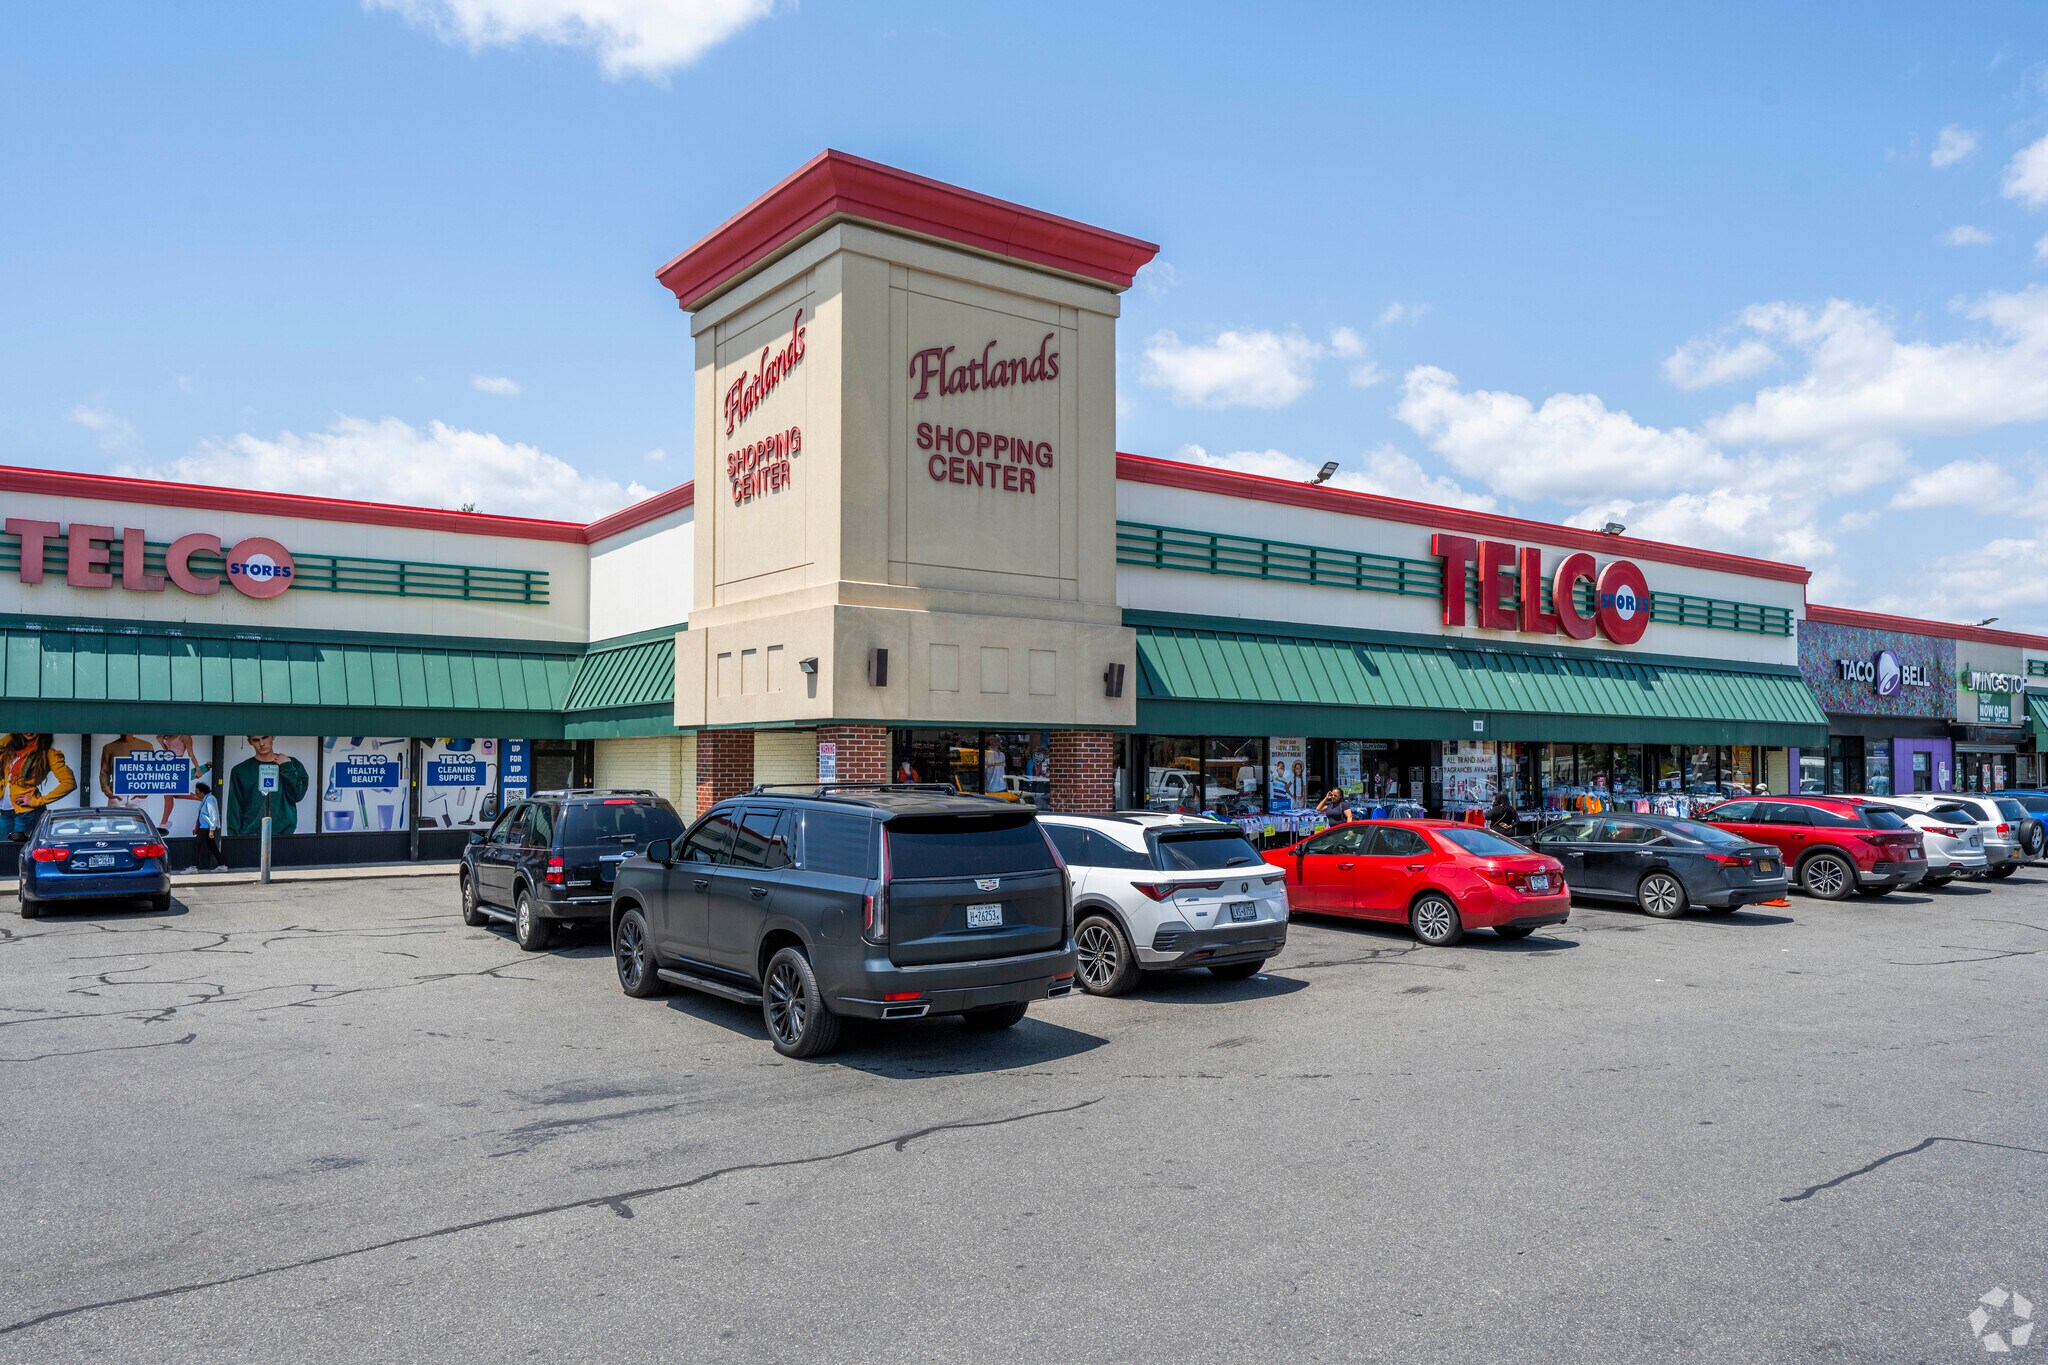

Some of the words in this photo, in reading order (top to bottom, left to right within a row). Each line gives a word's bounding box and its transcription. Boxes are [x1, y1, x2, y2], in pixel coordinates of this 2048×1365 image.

[724, 308, 806, 435] Flatlands
[910, 332, 1060, 400] Flatlands
[916, 422, 1054, 468] SHOPPING
[727, 426, 801, 477] SHOPPING
[928, 454, 1036, 494] CENTER
[732, 460, 791, 502] CENTER
[5, 518, 295, 598] TELCO
[230, 562, 292, 578] STORES
[1431, 533, 1650, 645] TELCO
[1601, 592, 1649, 612] STORES
[1840, 659, 1875, 682] TACO
[1902, 665, 1930, 687] BELL
[1979, 705, 1994, 717] NOW
[1994, 705, 2009, 718] OPEN
[131, 751, 175, 761] TELCO
[349, 755, 386, 765] TELCO
[439, 755, 475, 764] TELCO
[1446, 756, 1456, 764] ALL
[119, 763, 144, 772] MENS
[146, 763, 153, 772] &
[155, 763, 186, 772] LADIES
[347, 767, 378, 775] HEALTH
[380, 767, 386, 775] &
[437, 766, 476, 774] CLEANING
[126, 772, 171, 781] CLOTHING
[172, 772, 179, 781] &
[351, 775, 383, 783] BEAUTY
[438, 774, 475, 782] SUPPLIES
[503, 775, 528, 783] ACCESS
[128, 781, 177, 790] FOOTWEAR
